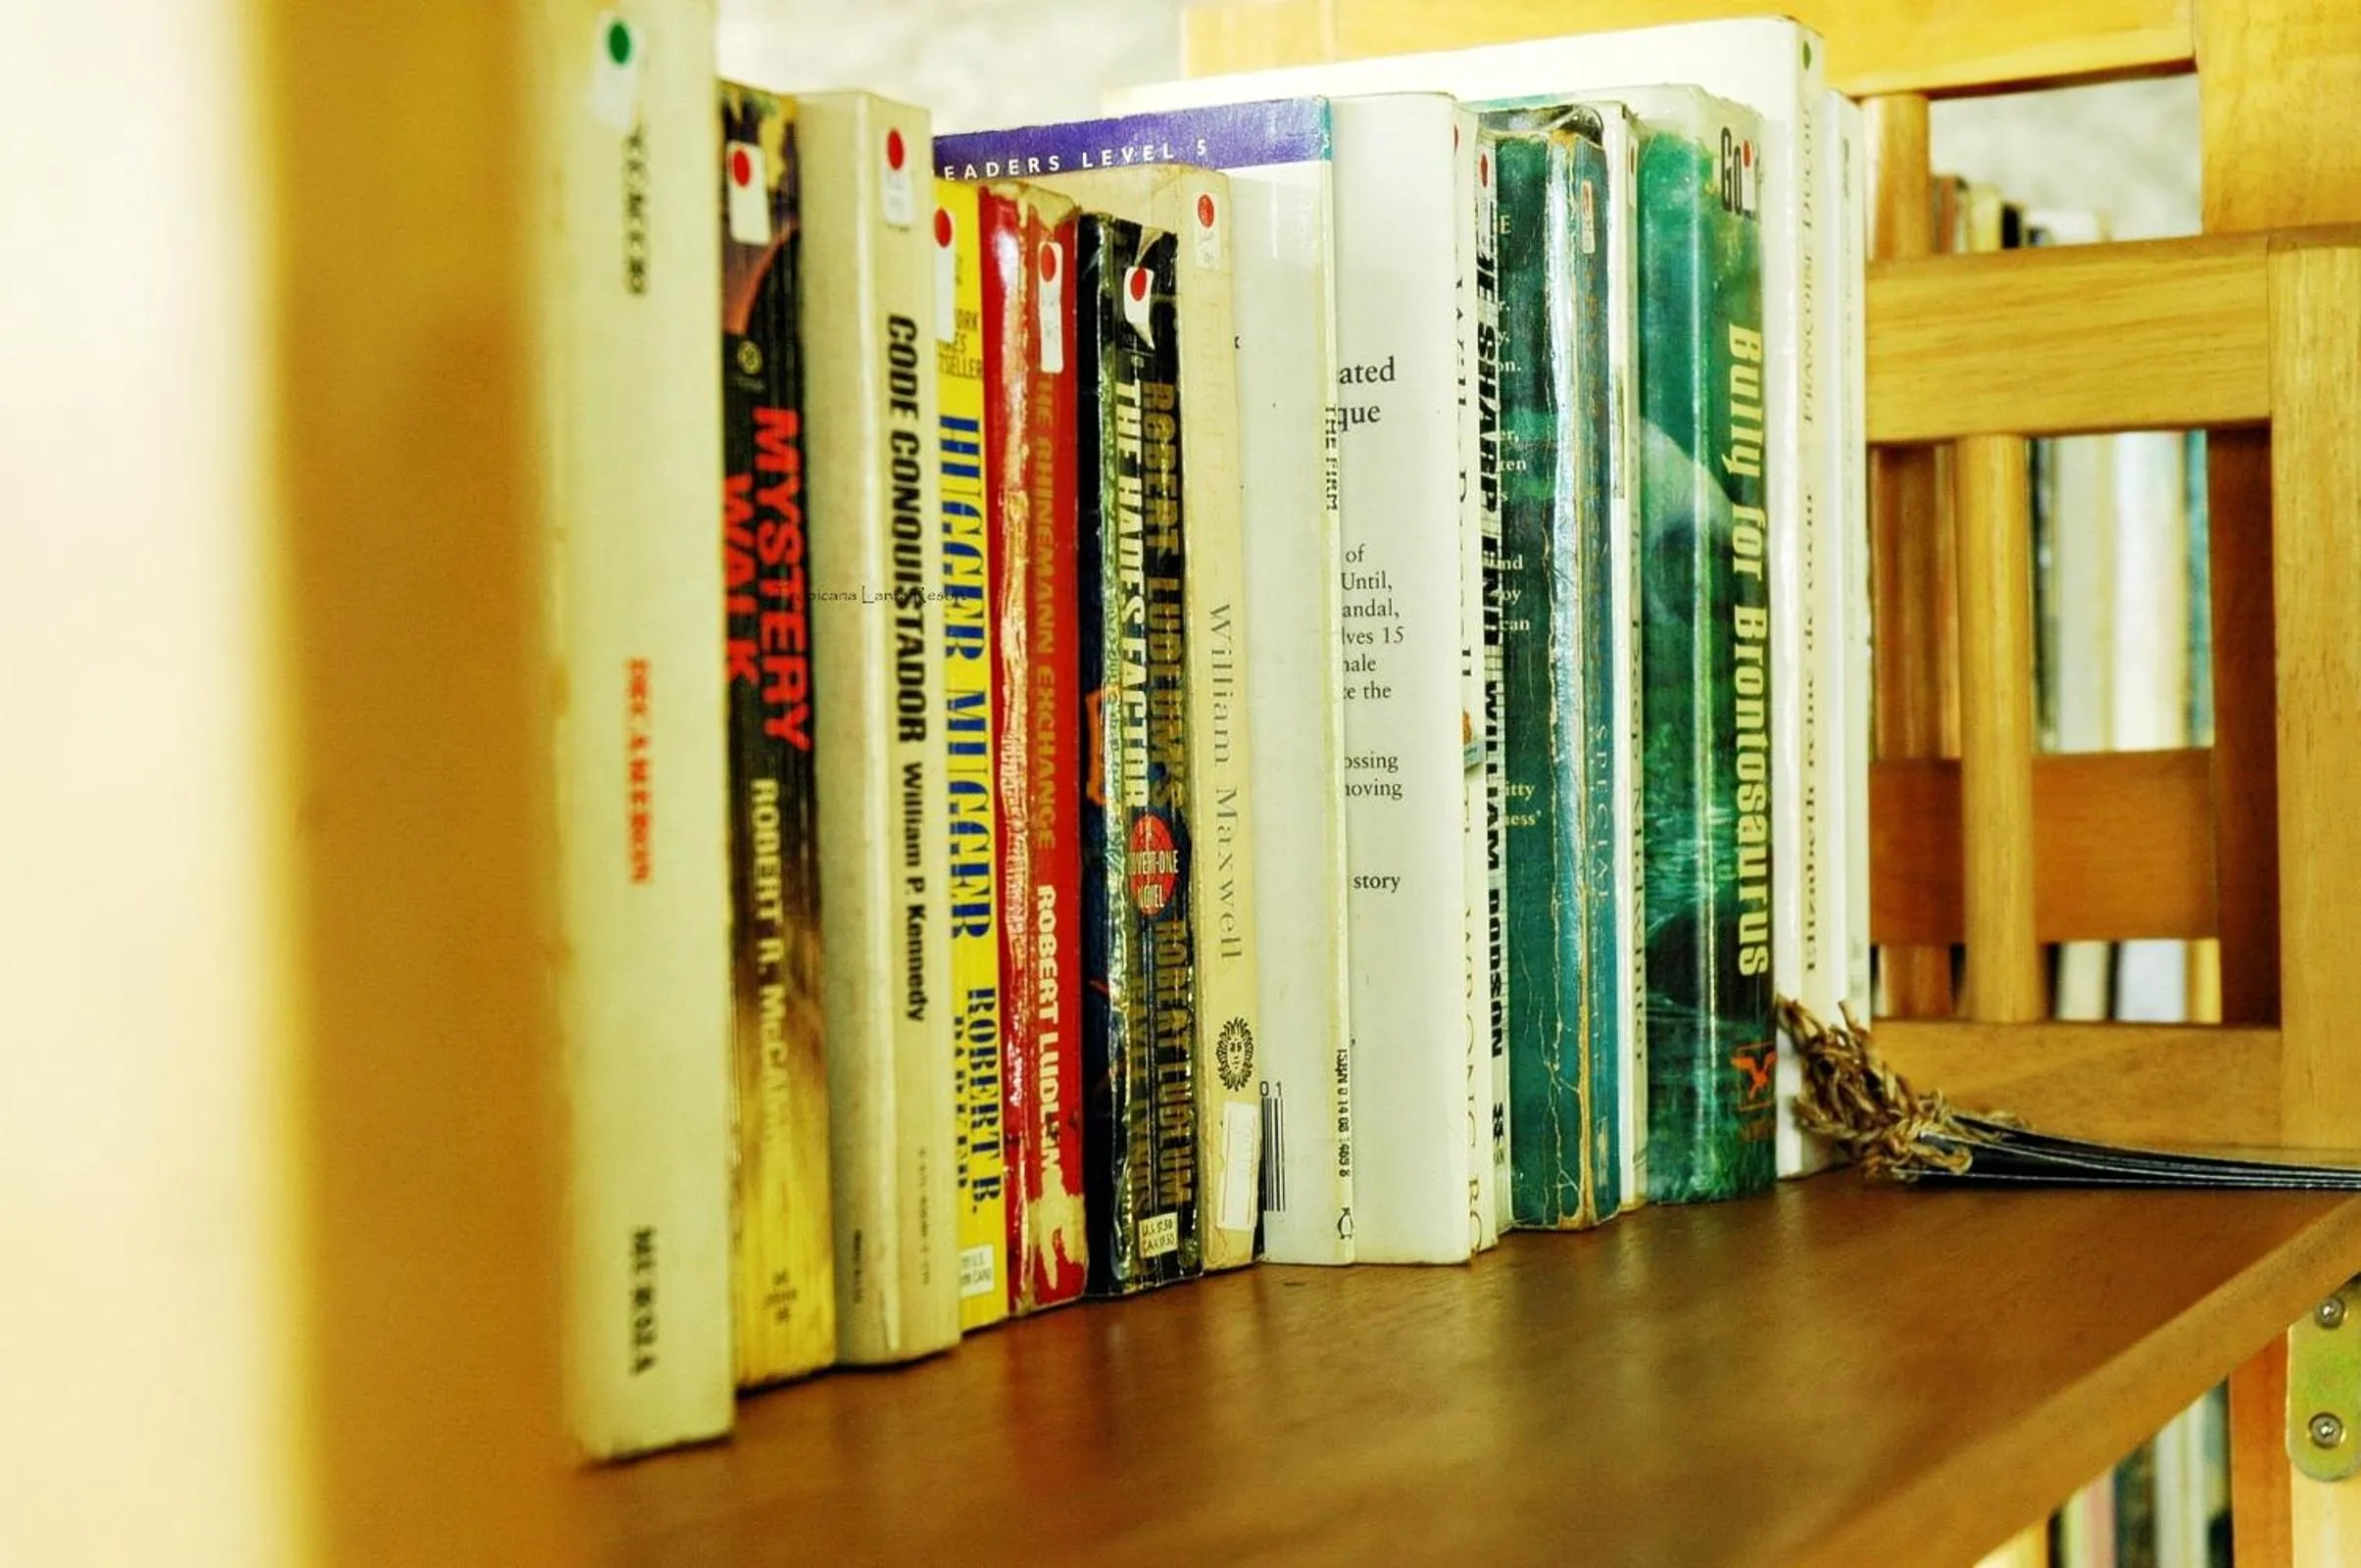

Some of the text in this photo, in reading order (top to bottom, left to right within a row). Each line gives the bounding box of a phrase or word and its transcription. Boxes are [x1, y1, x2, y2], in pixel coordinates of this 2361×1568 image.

[944, 138, 1207, 181] EADERS LEVEL 5
[1116, 380, 1141, 466] THE
[1338, 405, 1381, 432] que
[1339, 355, 1396, 384] ated
[1478, 320, 1498, 513] SHARP
[1142, 381, 1180, 557] ROBERT
[1325, 405, 1339, 511] THE FIRM
[752, 406, 812, 752] MYSTERY
[888, 314, 928, 743] CODE CONQUISTADOR
[939, 415, 986, 662] HUGGER
[1034, 436, 1056, 655] RHINEMANN
[1341, 569, 1393, 593] Until,
[1346, 543, 1365, 564] of
[1342, 597, 1400, 619] andal,
[1342, 625, 1405, 647] lves 15
[1482, 535, 1500, 646] END
[1722, 323, 1769, 976] Bully for Brontosaurus
[1120, 638, 1149, 808] FACTOR
[1363, 680, 1392, 700] the
[902, 762, 925, 868] William
[945, 689, 992, 939] MUGGER
[1036, 663, 1058, 851] EXCHANGE
[1209, 603, 1244, 962] William Maxwell
[1345, 751, 1399, 774] ossing
[750, 778, 785, 924] ROBERT
[1353, 874, 1401, 894] story
[1485, 680, 1504, 1058] WILLIAM DODSON
[906, 905, 929, 1023] Kennedy
[1037, 884, 1059, 1025] ROBERT
[966, 987, 1002, 1160] ROBERT
[1156, 921, 1193, 1206] ROBERT LUDLUM
[1336, 1049, 1349, 1084] ISBN
[971, 1175, 1003, 1214] B.
